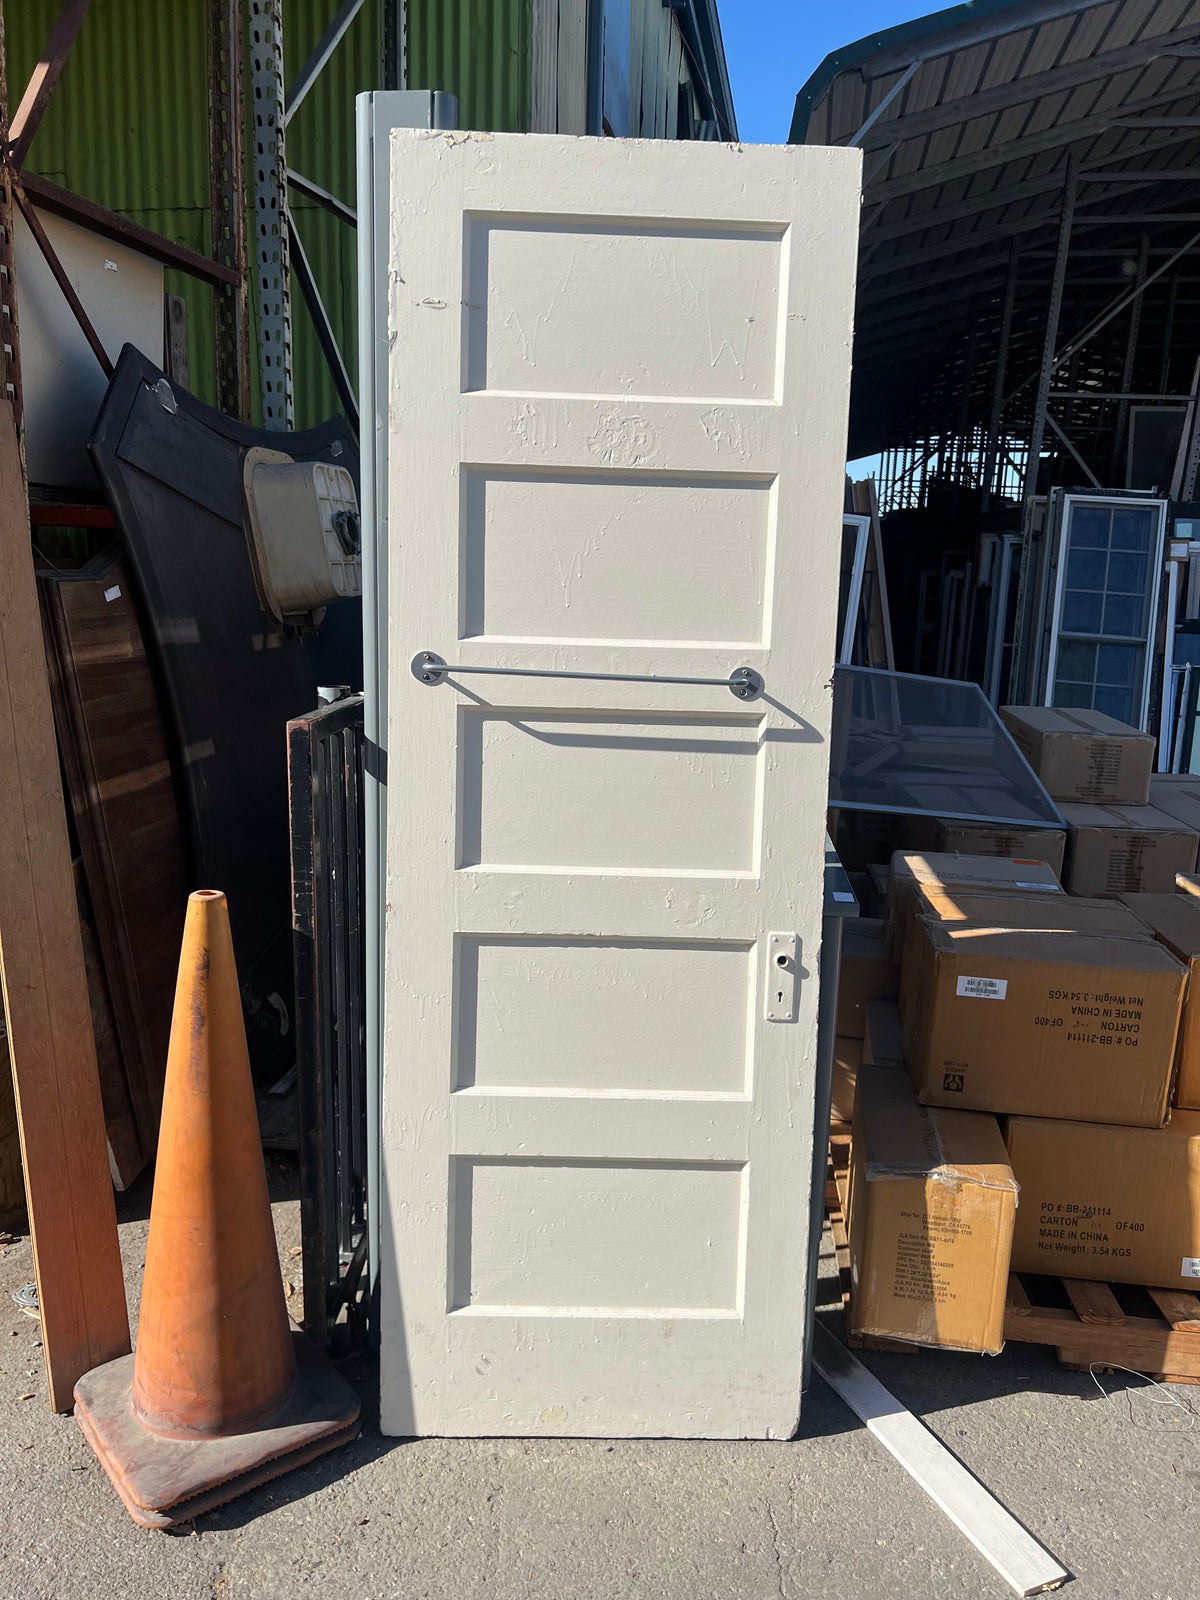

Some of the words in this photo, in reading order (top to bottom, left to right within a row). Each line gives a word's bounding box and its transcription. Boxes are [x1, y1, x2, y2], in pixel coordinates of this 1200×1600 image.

[1048, 990, 1069, 1000] KGS
[1071, 992, 1089, 1001] 3.54
[1129, 997, 1144, 1006] Net
[1071, 1006, 1100, 1016] CHINA
[1102, 1009, 1112, 1018] IN
[1115, 1009, 1142, 1020] MADE
[1101, 1021, 1140, 1033] CARTON
[1067, 1032, 1112, 1045] BB-211114
[1125, 1037, 1138, 1046] PO
[1041, 1203, 1054, 1212] PO
[1066, 1204, 1111, 1216] BB-211114
[1040, 1216, 1078, 1227] CARTON
[1039, 1228, 1065, 1239] MADE
[1068, 1231, 1077, 1240] IN
[1080, 1231, 1109, 1242] CHINA
[1038, 1241, 1053, 1251] Net
[1091, 1246, 1109, 1255] 3.54
[1111, 1248, 1131, 1257] KGS
